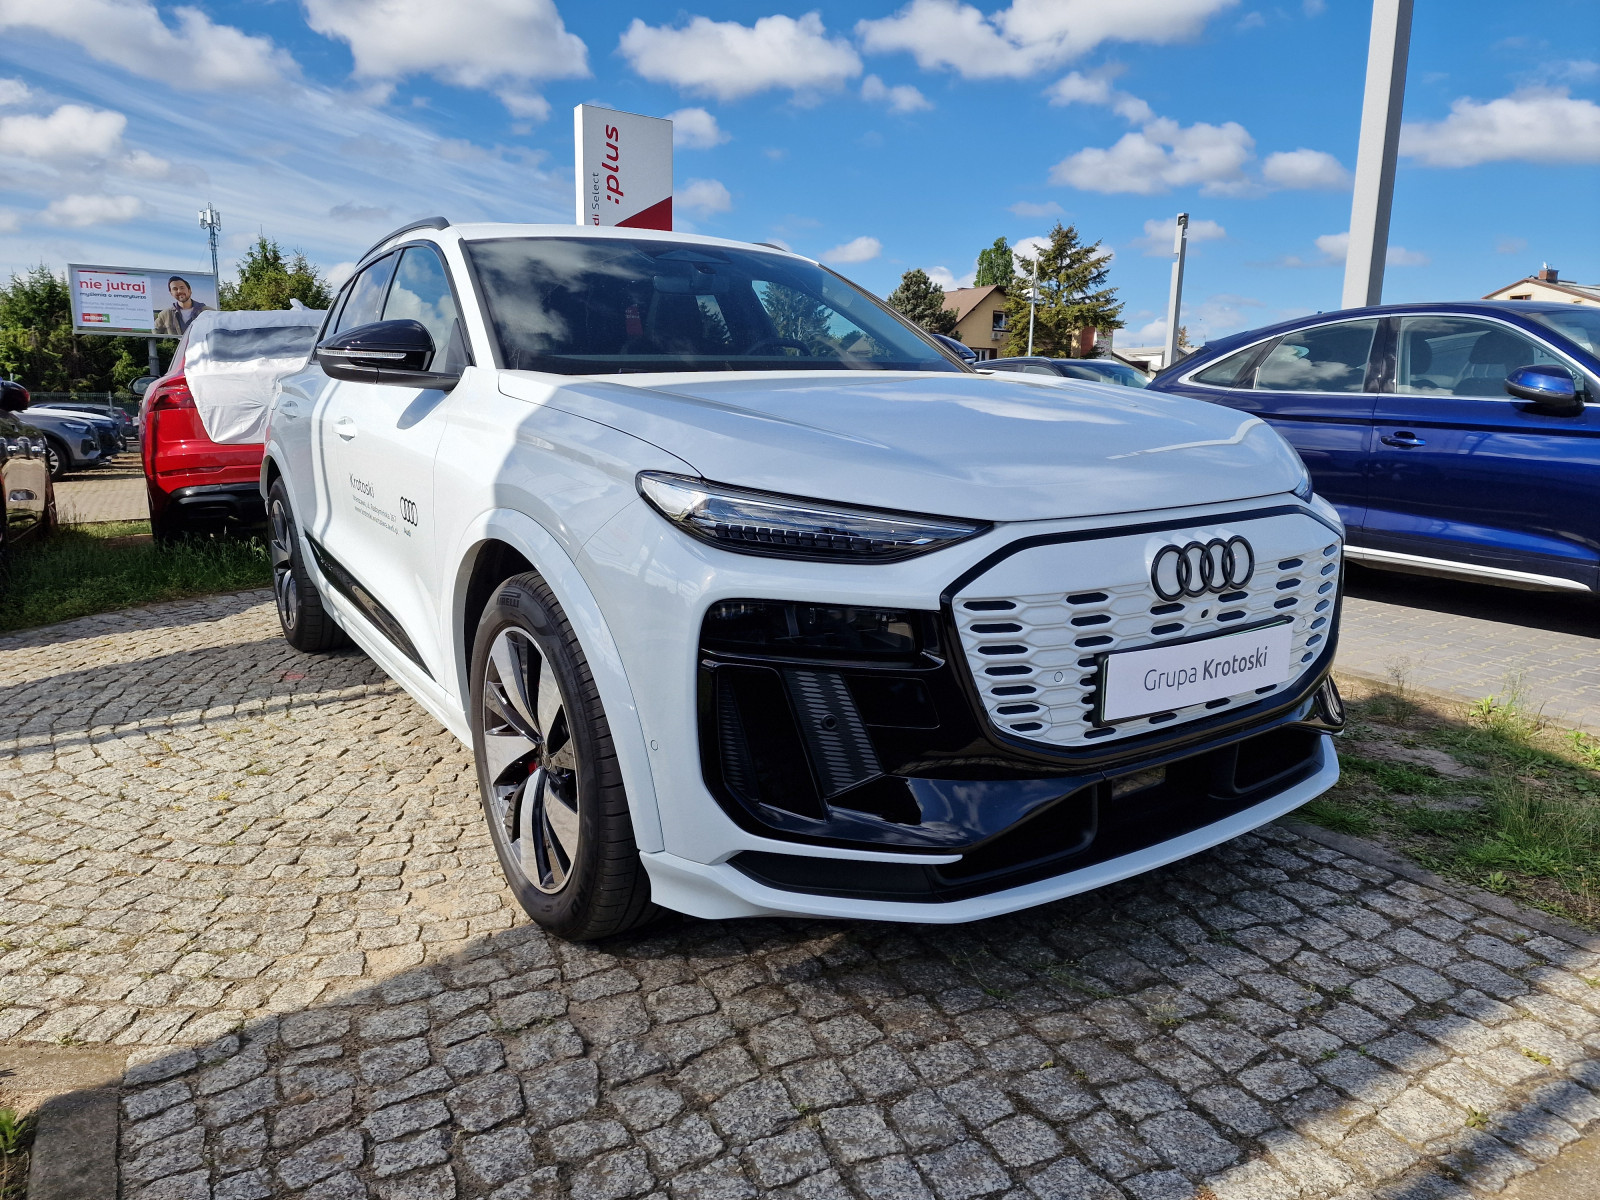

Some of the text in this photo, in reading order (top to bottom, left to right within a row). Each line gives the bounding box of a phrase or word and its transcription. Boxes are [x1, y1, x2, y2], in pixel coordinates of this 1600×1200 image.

[592, 172, 600, 226] di Select
[80, 278, 146, 294] nie jutraj
[349, 473, 375, 498] Krotoski
[496, 590, 522, 608] PIRELLI
[1144, 645, 1269, 692] Grupa Krotoski
